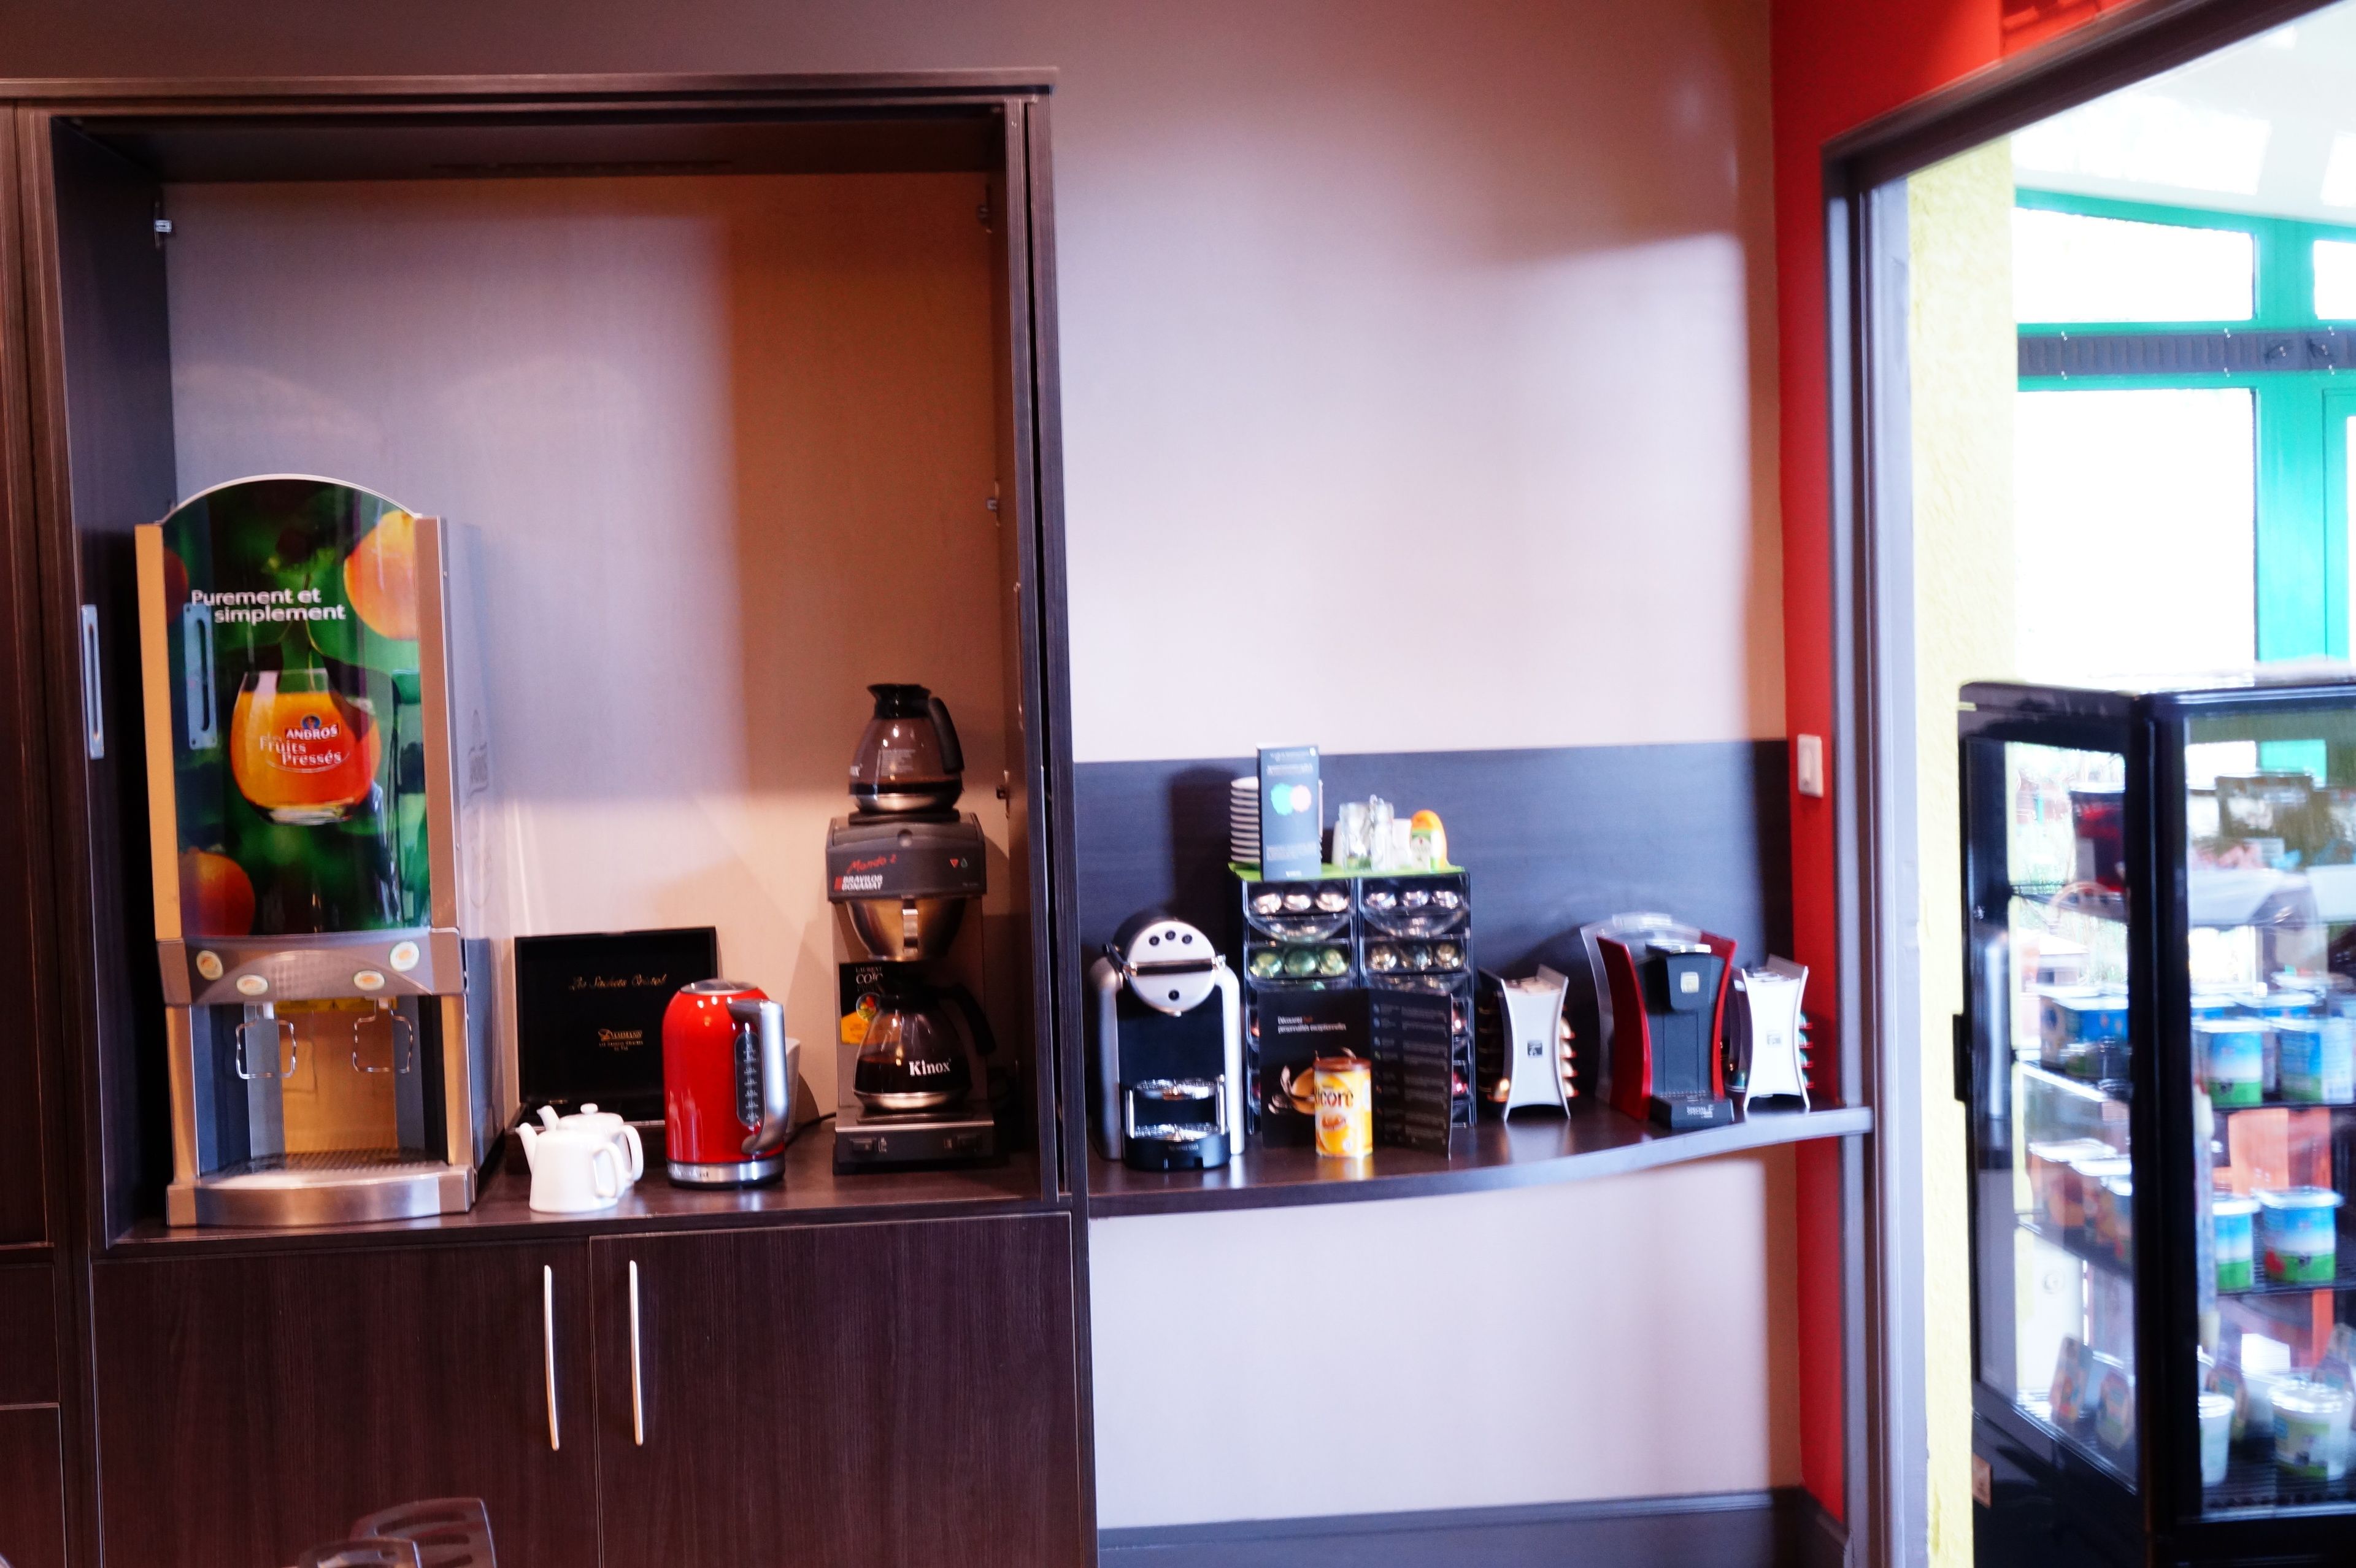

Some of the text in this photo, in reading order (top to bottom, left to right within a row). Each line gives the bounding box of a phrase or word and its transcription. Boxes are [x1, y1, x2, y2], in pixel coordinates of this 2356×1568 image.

[191, 588, 321, 606] Purement et
[215, 604, 346, 626] simplement
[286, 724, 338, 740] ANDROS
[260, 734, 306, 753] Fruits
[282, 750, 342, 766] Pressés
[908, 1059, 950, 1077] Kinox
